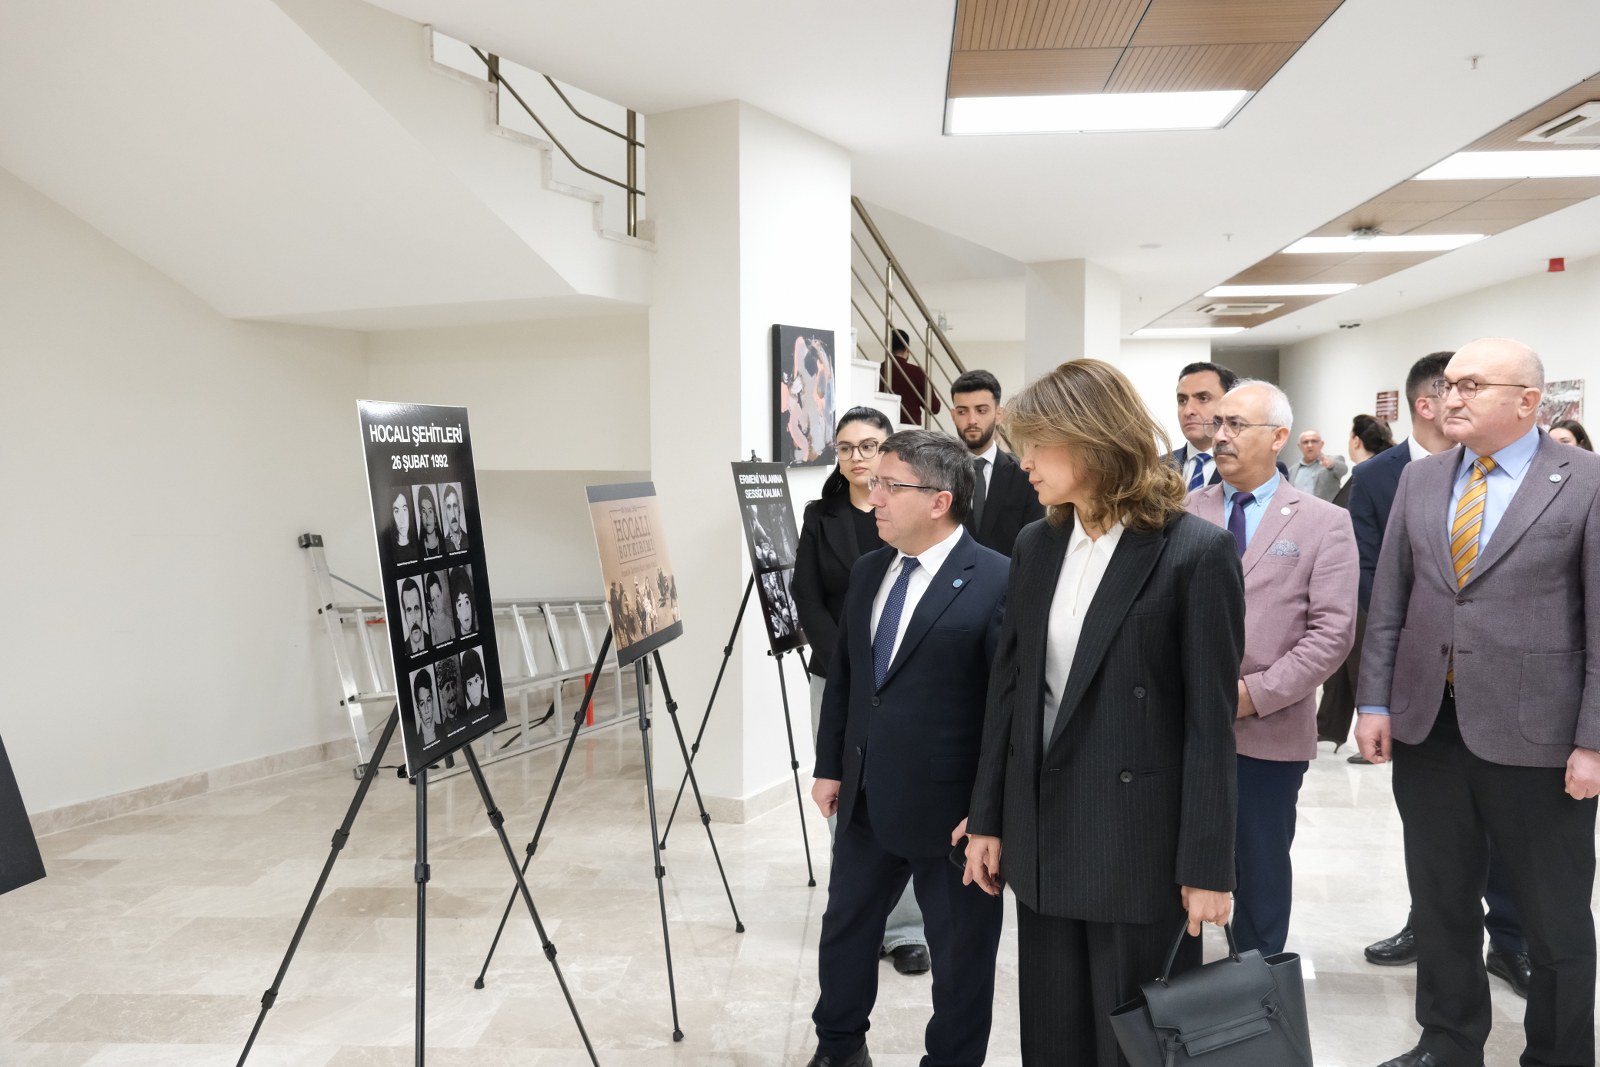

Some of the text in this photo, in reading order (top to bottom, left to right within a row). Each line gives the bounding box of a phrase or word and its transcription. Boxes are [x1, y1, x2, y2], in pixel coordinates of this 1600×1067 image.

[369, 422, 463, 447] HOCALI ŞEHİTLERİ
[391, 454, 448, 472] 26 ŞUBAT 1992
[613, 515, 651, 542] HOCALI
